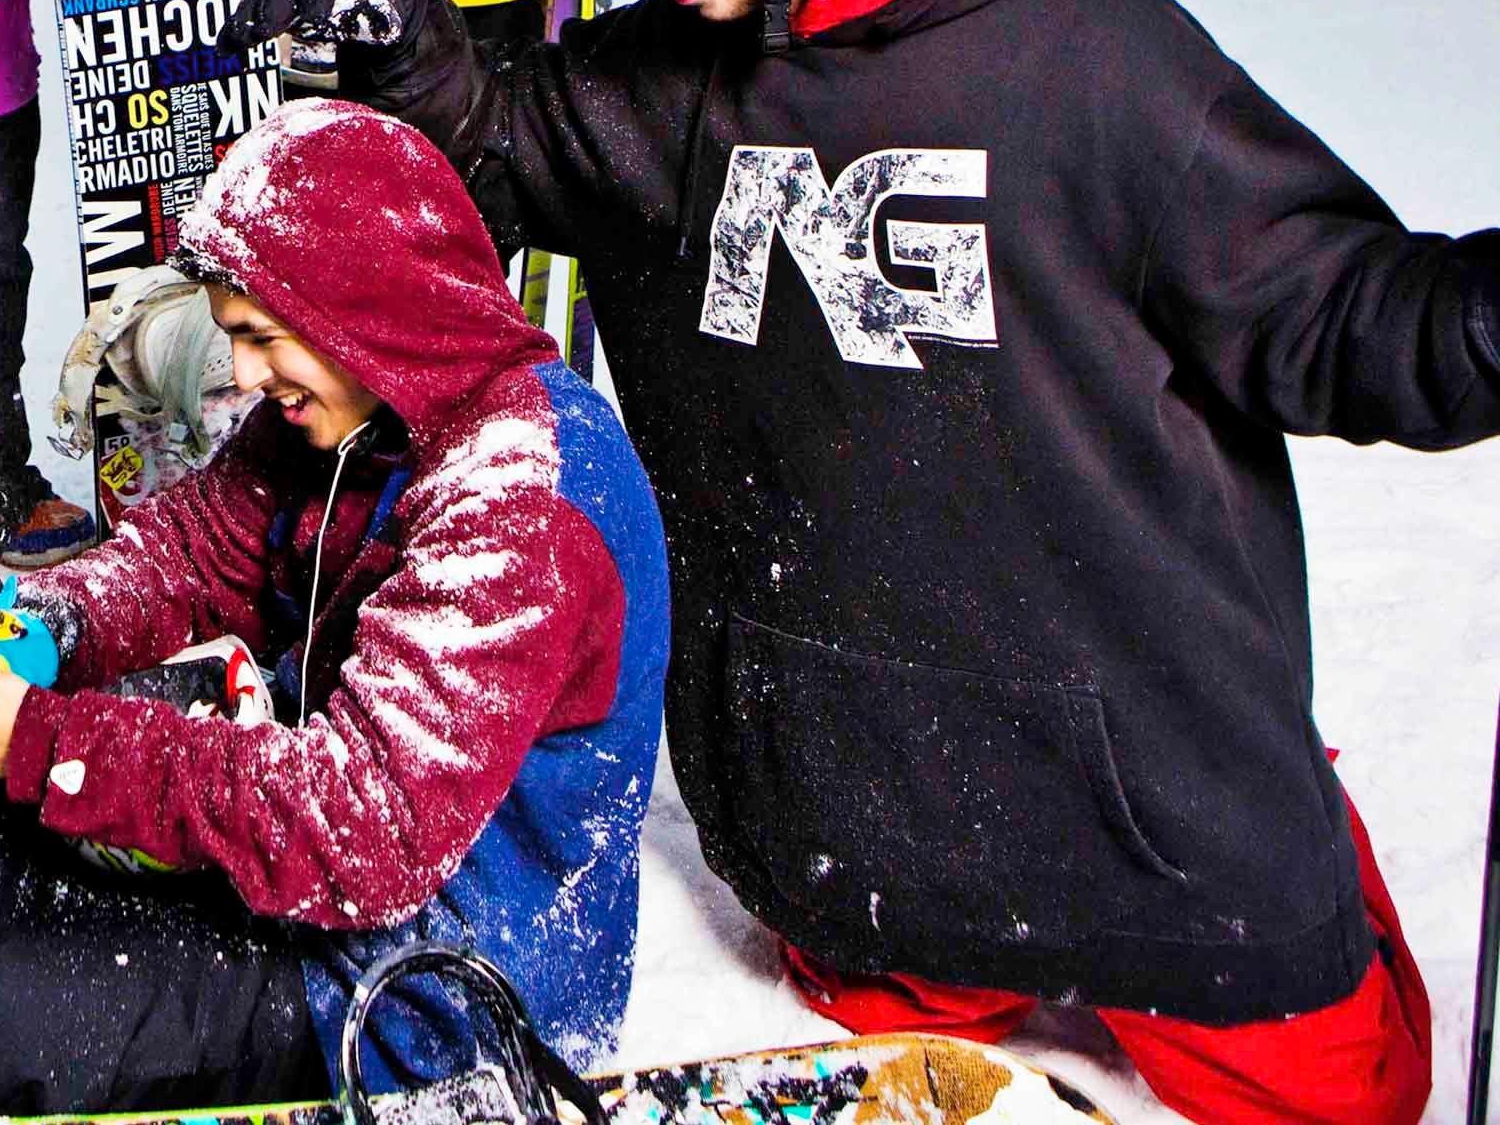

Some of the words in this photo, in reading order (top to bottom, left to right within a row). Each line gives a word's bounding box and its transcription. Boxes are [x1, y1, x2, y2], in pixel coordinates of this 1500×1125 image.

[70, 59, 151, 101] DEINE
[127, 89, 170, 130] SO
[170, 86, 182, 112] DANS
[198, 92, 210, 111] SAIS
[172, 113, 184, 132] TON
[181, 83, 204, 173] SQUELETTES
[200, 112, 211, 129] QUE
[202, 129, 212, 141] TU
[76, 126, 174, 165] CHELETRI
[174, 133, 189, 175] ARMOIRE
[203, 142, 213, 153] AS
[79, 150, 176, 194] RMADIO
[204, 154, 215, 170] DES
[160, 181, 177, 215] DEINE
